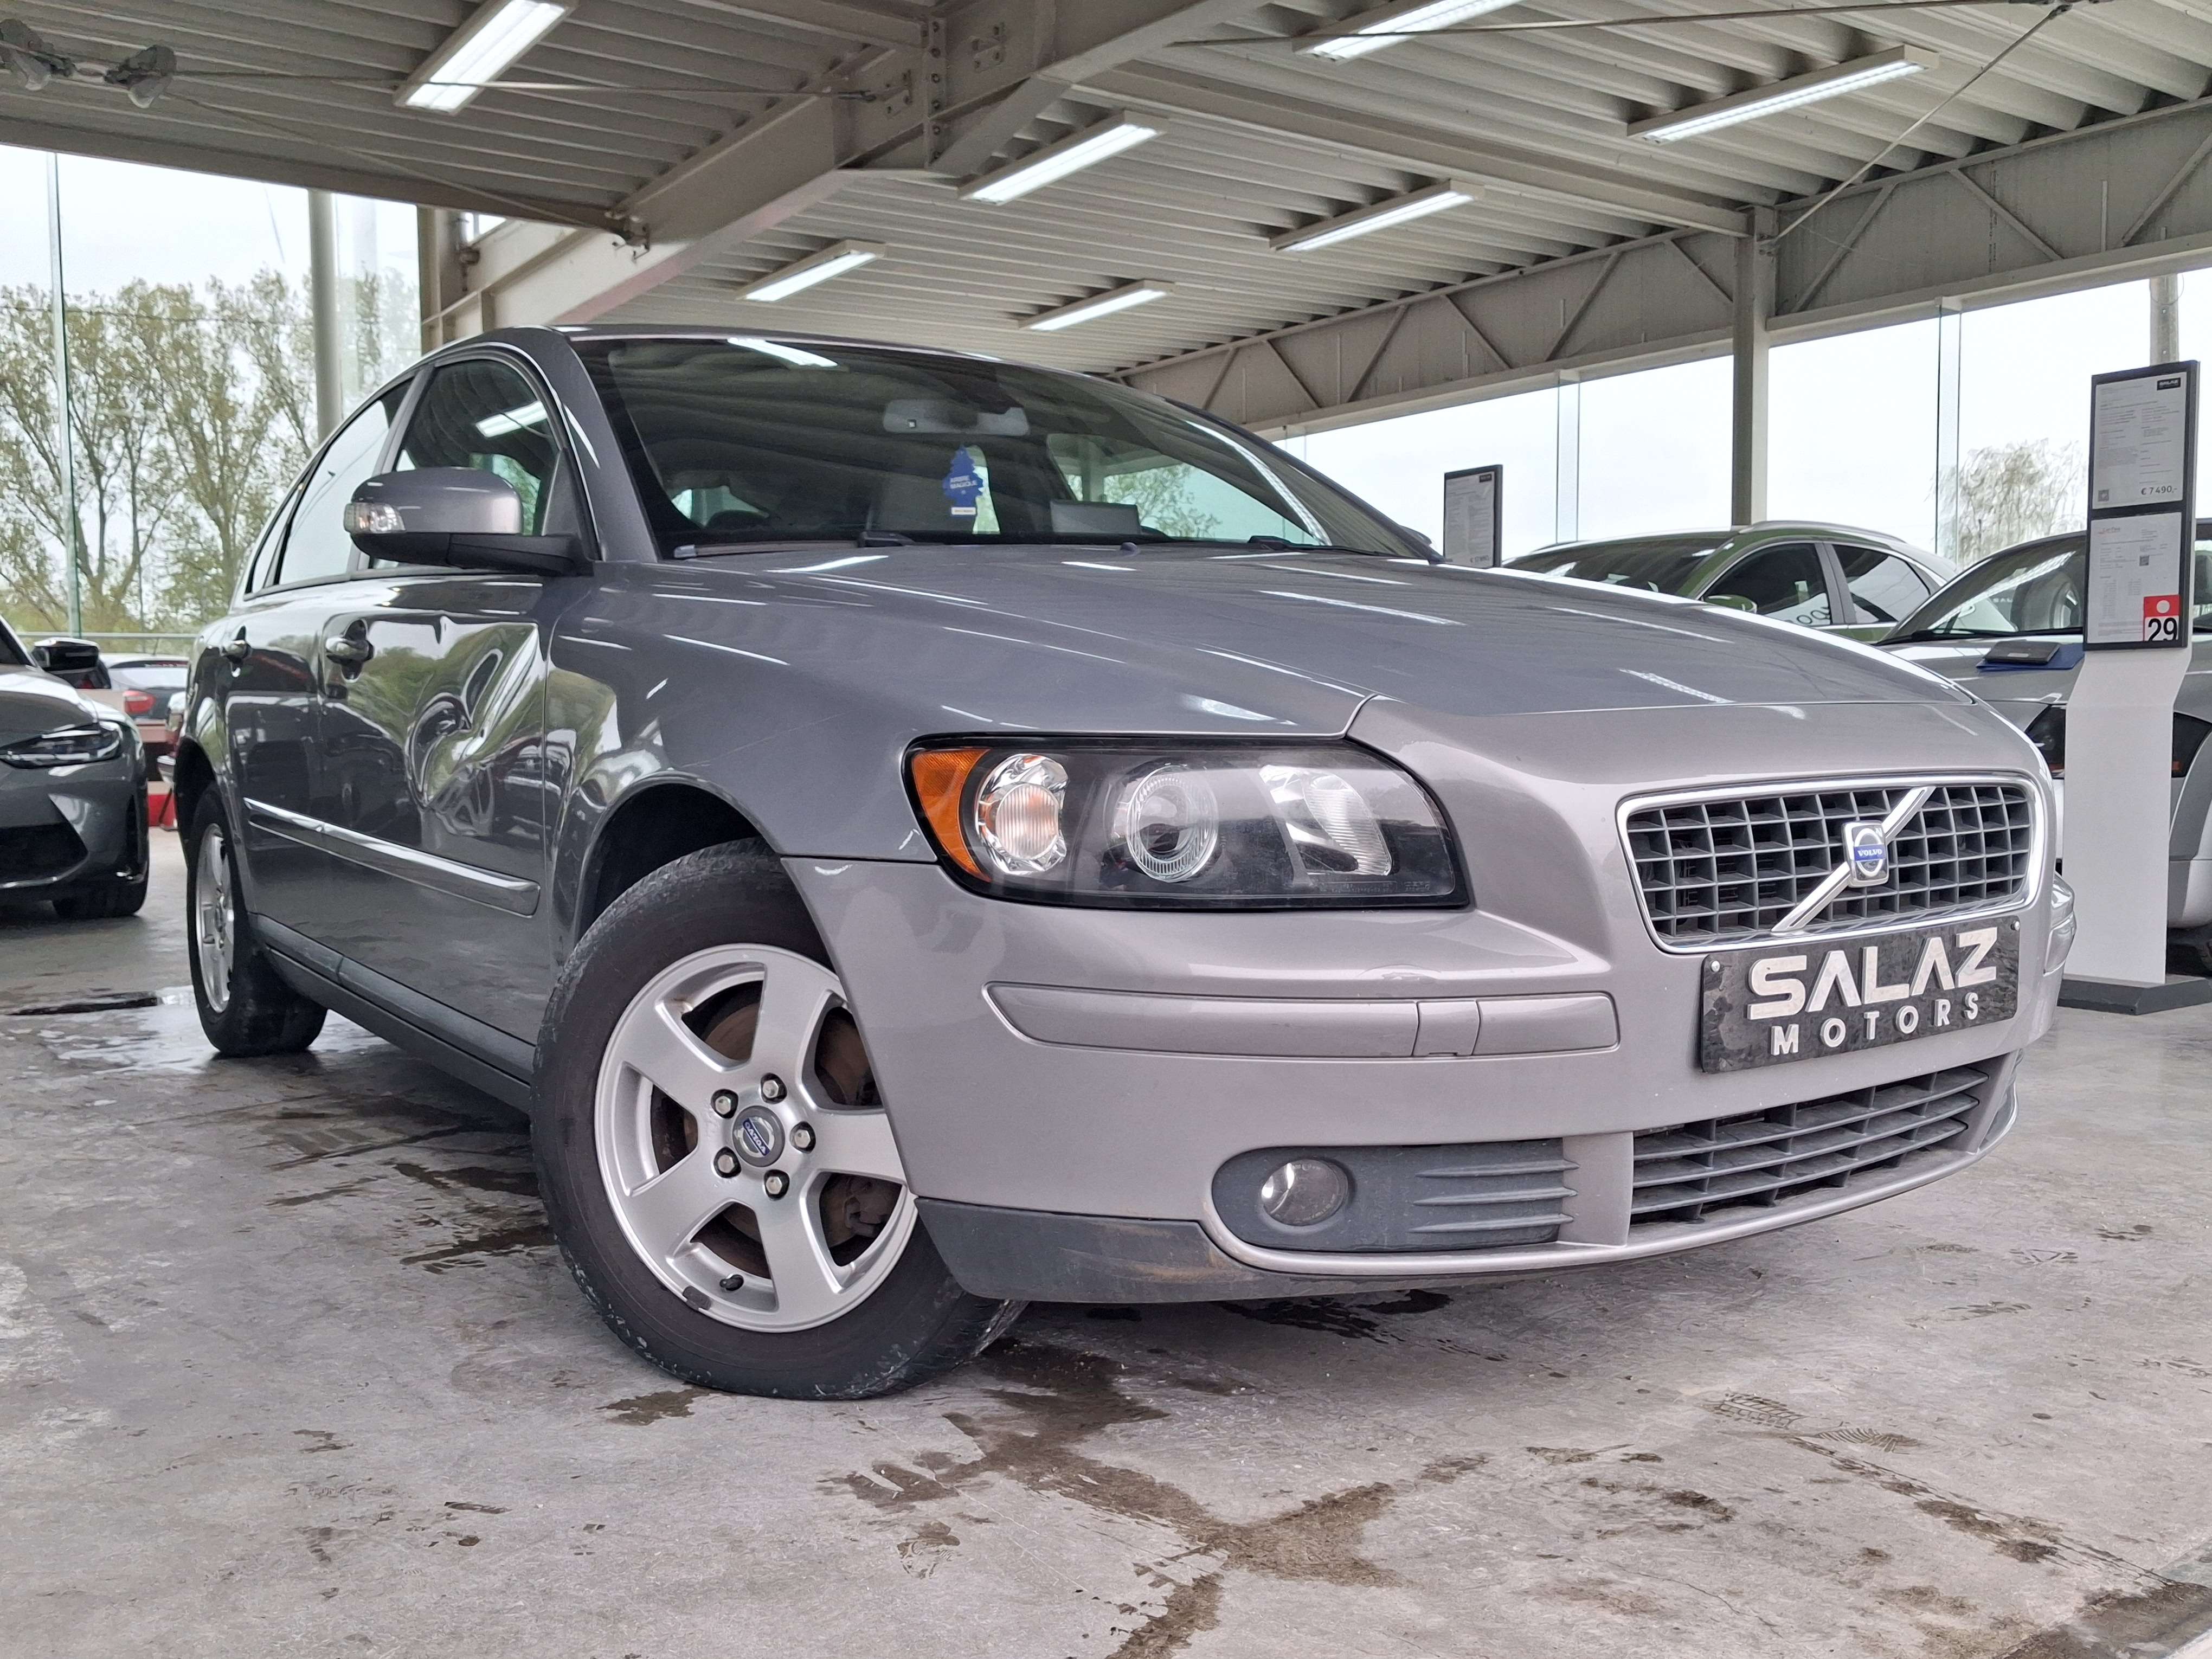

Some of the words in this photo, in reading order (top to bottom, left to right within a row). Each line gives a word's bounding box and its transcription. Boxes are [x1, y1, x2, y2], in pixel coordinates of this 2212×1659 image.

[2148, 617, 2178, 642] 29
[1857, 848, 1883, 857] VOLVO
[1747, 927, 1998, 1020] SALAZ
[1771, 992, 1979, 1056] MOTORS
[744, 1121, 767, 1156] VOLVO
